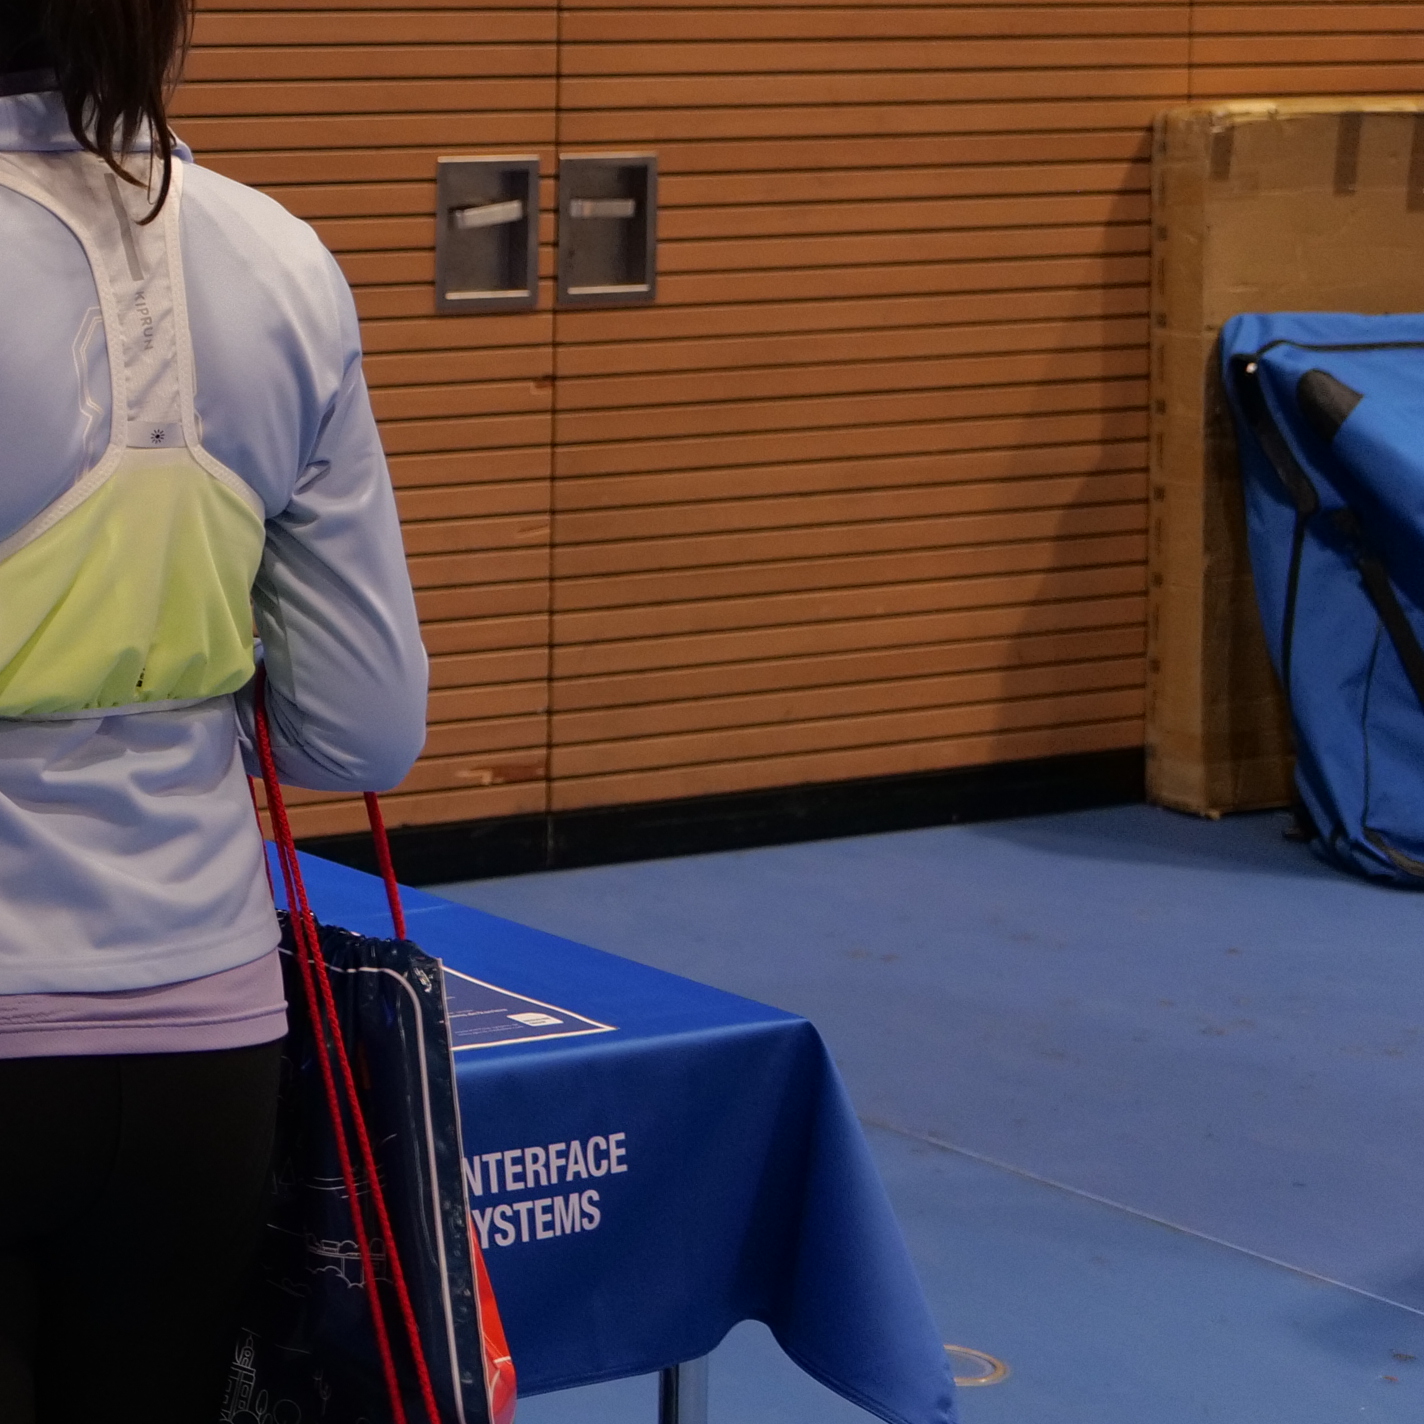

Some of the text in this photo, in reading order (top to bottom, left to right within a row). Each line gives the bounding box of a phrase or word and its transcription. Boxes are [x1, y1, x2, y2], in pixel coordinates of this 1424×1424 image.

[134, 290, 154, 351] KIPRUN
[461, 1132, 628, 1197] NTERFACE
[471, 1189, 601, 1249] YSTEMS
